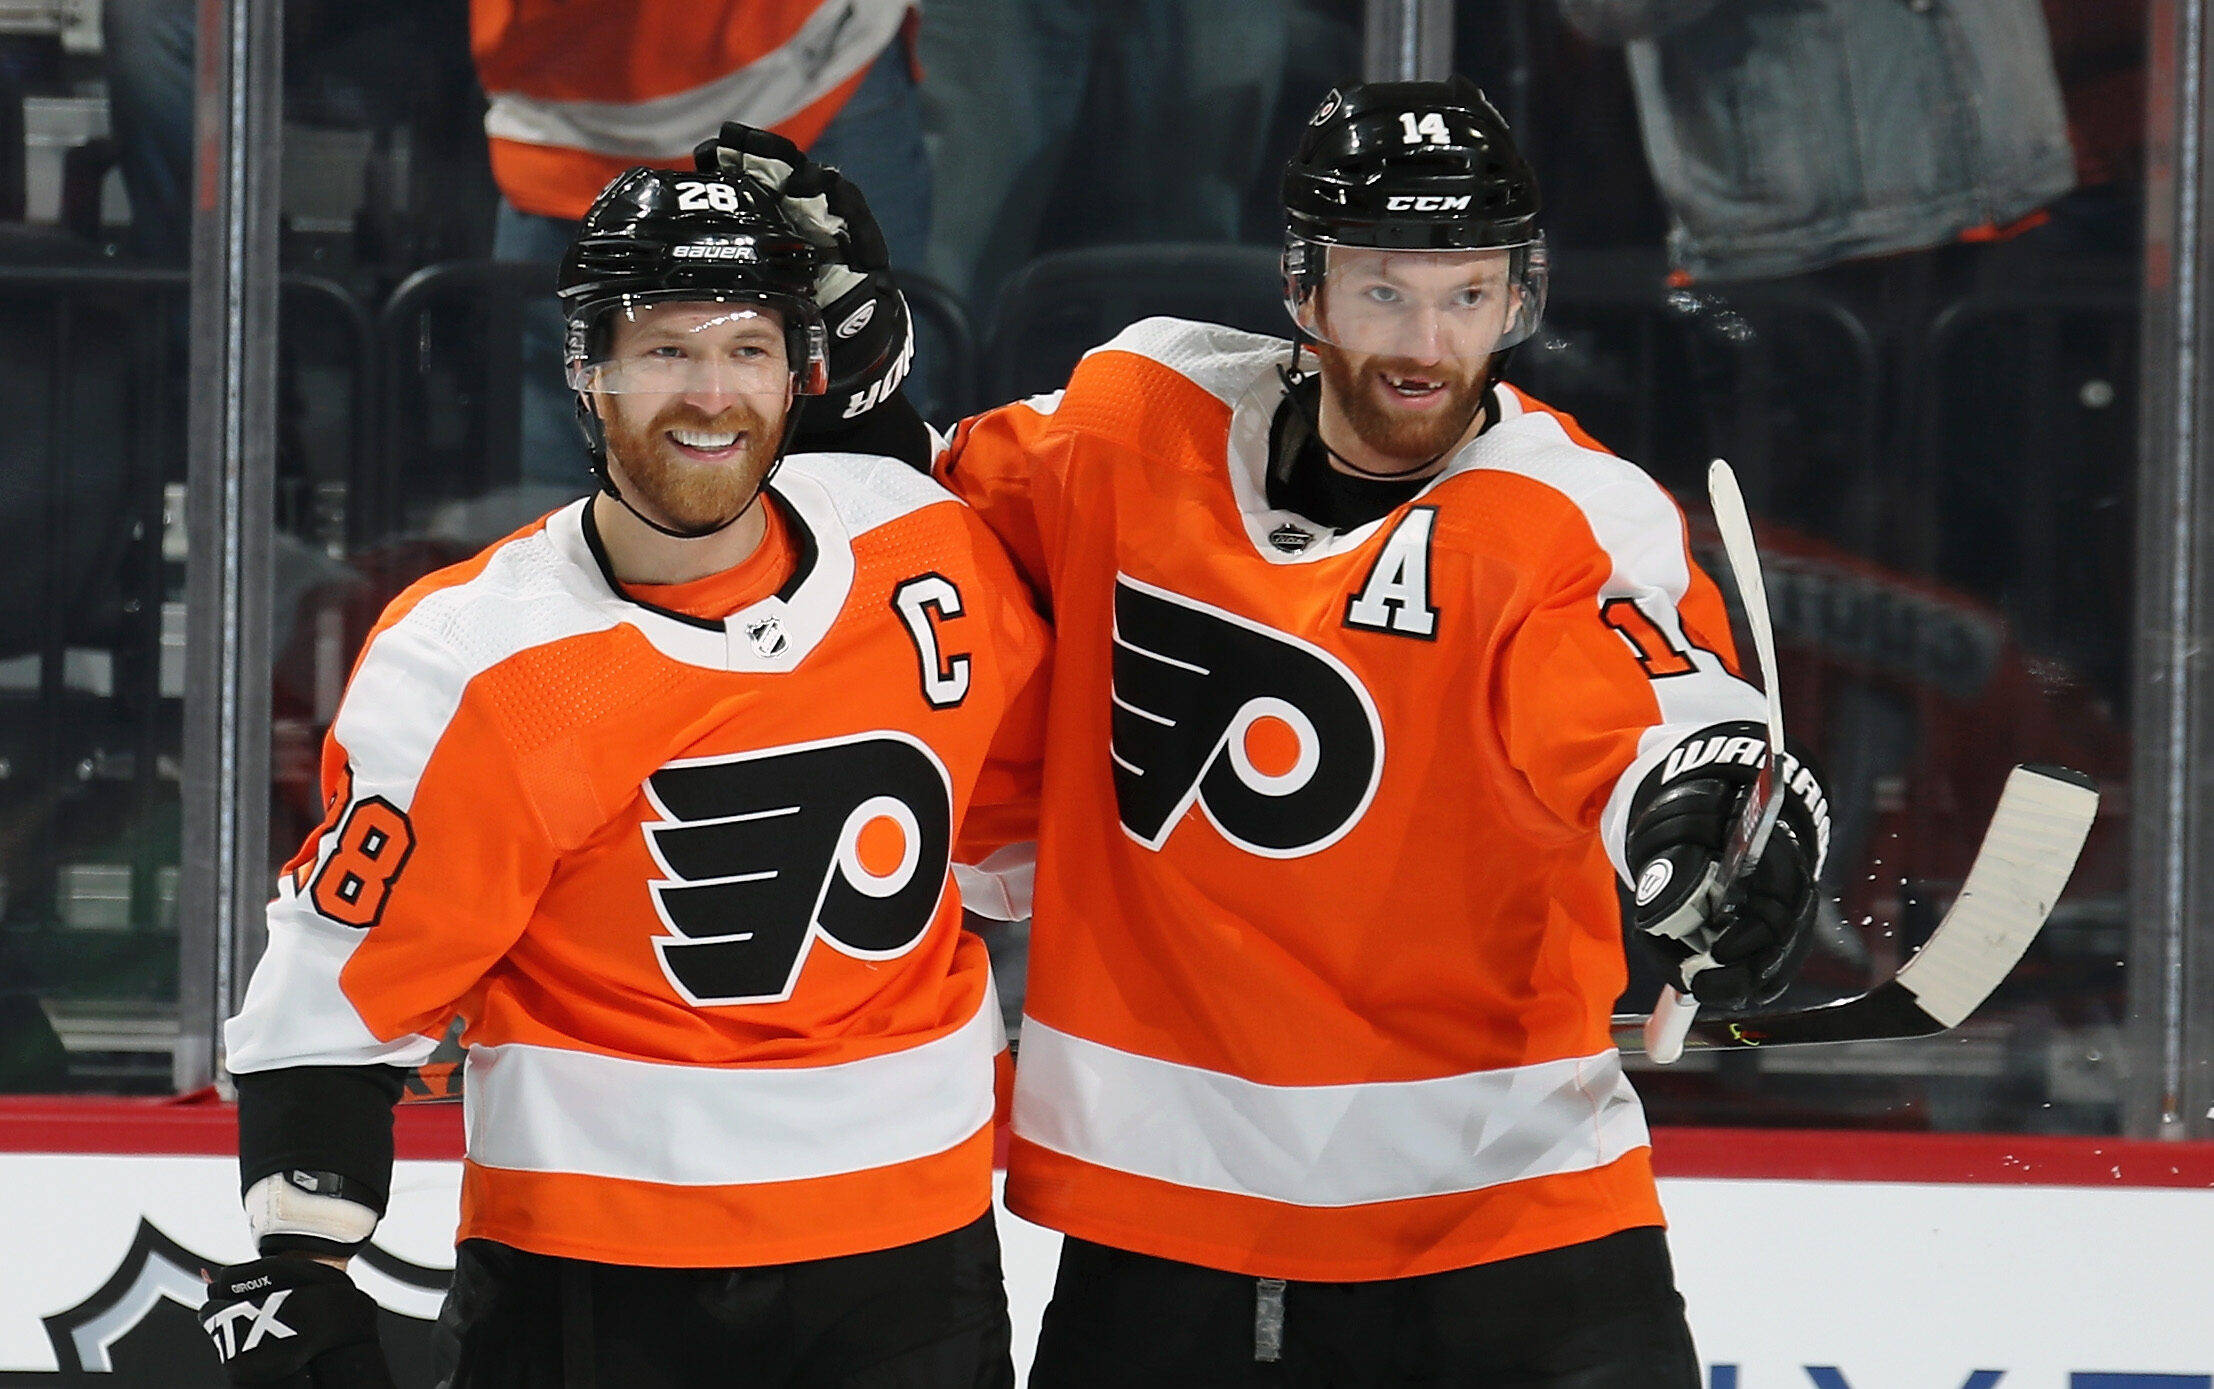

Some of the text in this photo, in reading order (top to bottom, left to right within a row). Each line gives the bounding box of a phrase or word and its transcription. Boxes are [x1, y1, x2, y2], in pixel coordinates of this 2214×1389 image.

[1399, 112, 1451, 144] 14
[675, 181, 739, 212] 28
[1386, 195, 1472, 212] CCM
[673, 245, 757, 260] BAUER
[1342, 505, 1441, 642] A
[890, 571, 972, 711] C
[231, 1275, 273, 1294] GIROUX
